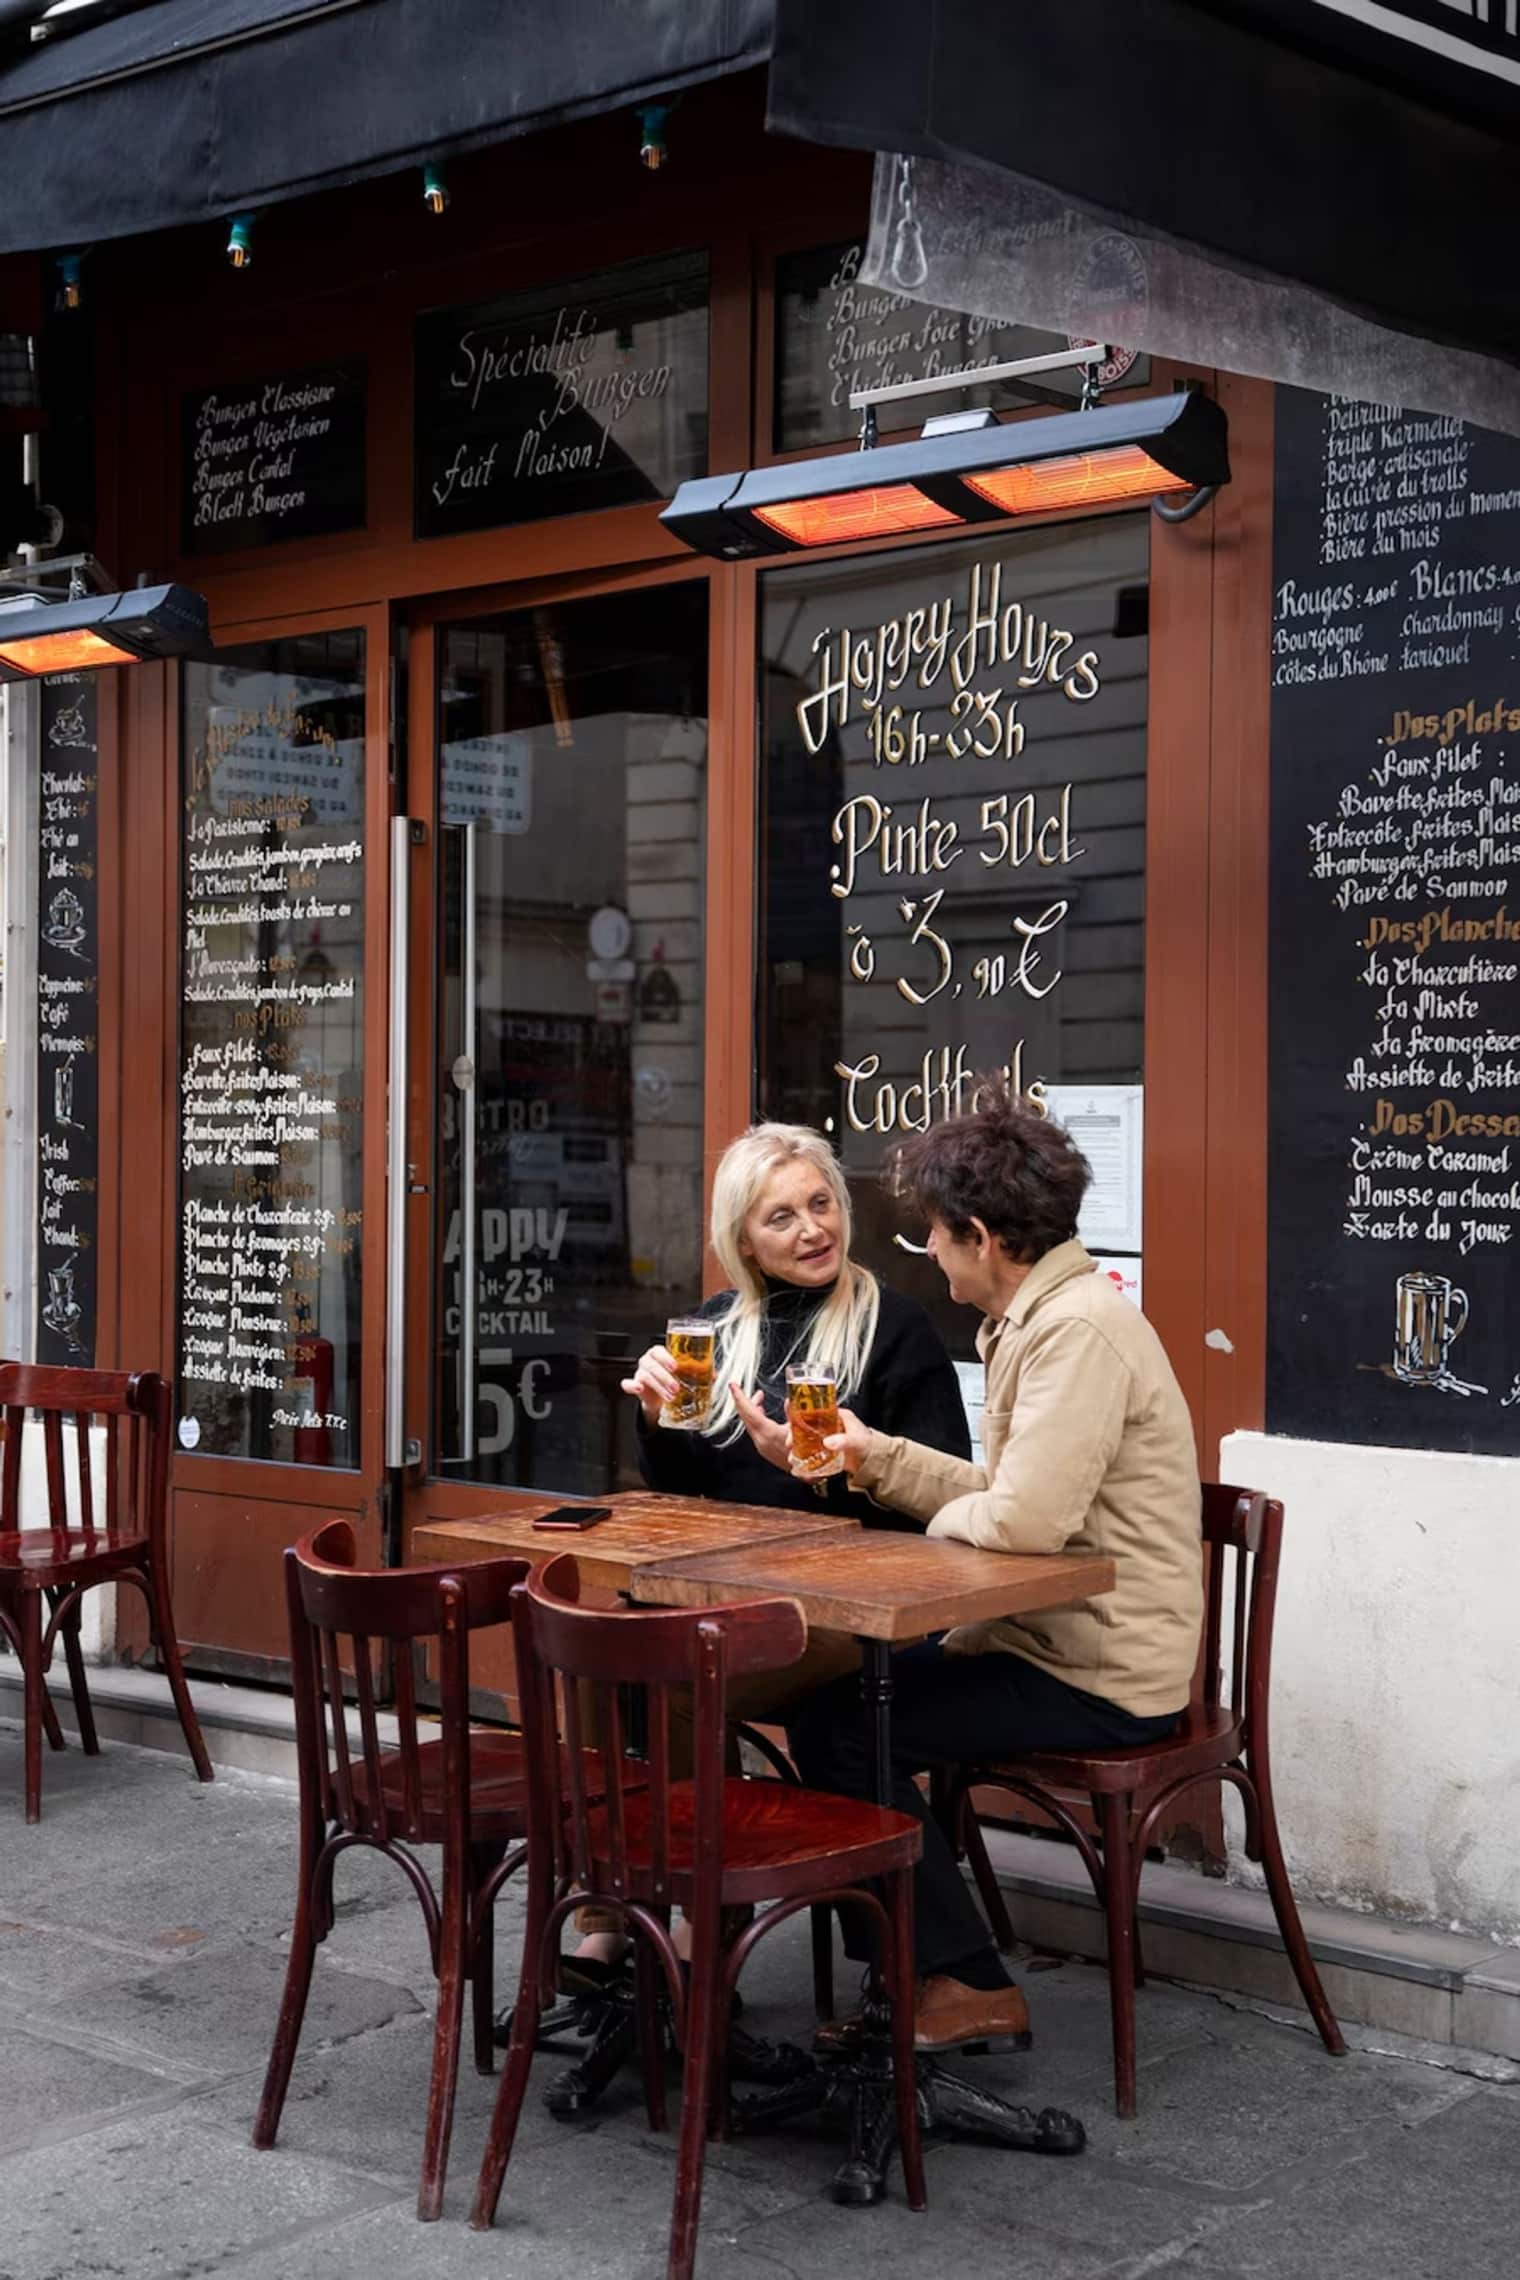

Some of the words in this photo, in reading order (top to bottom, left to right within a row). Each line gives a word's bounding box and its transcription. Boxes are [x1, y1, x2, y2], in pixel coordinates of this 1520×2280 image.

[451, 307, 598, 411] Spécialité
[828, 326, 912, 371] Burger
[538, 365, 671, 431] Burger
[1446, 492, 1465, 519] du
[1372, 530, 1395, 556] du
[1402, 598, 1504, 637] Chardonnay
[797, 597, 954, 754] Happy
[950, 561, 1100, 702] Hours
[1274, 623, 1364, 657] Bourgogne
[866, 687, 1027, 770] 16h-23h
[831, 794, 965, 899] Pinte
[979, 783, 1086, 869] 50cl
[1394, 873, 1419, 901] de
[1439, 1058, 1464, 1089] de
[1426, 1144, 1512, 1174] Caramel
[1348, 1173, 1433, 1207] Mousse
[1436, 1189, 1457, 1208] au
[1425, 1208, 1451, 1241] du
[1458, 1219, 1514, 1256] Jour
[445, 1306, 555, 1336] CCKTAIL
